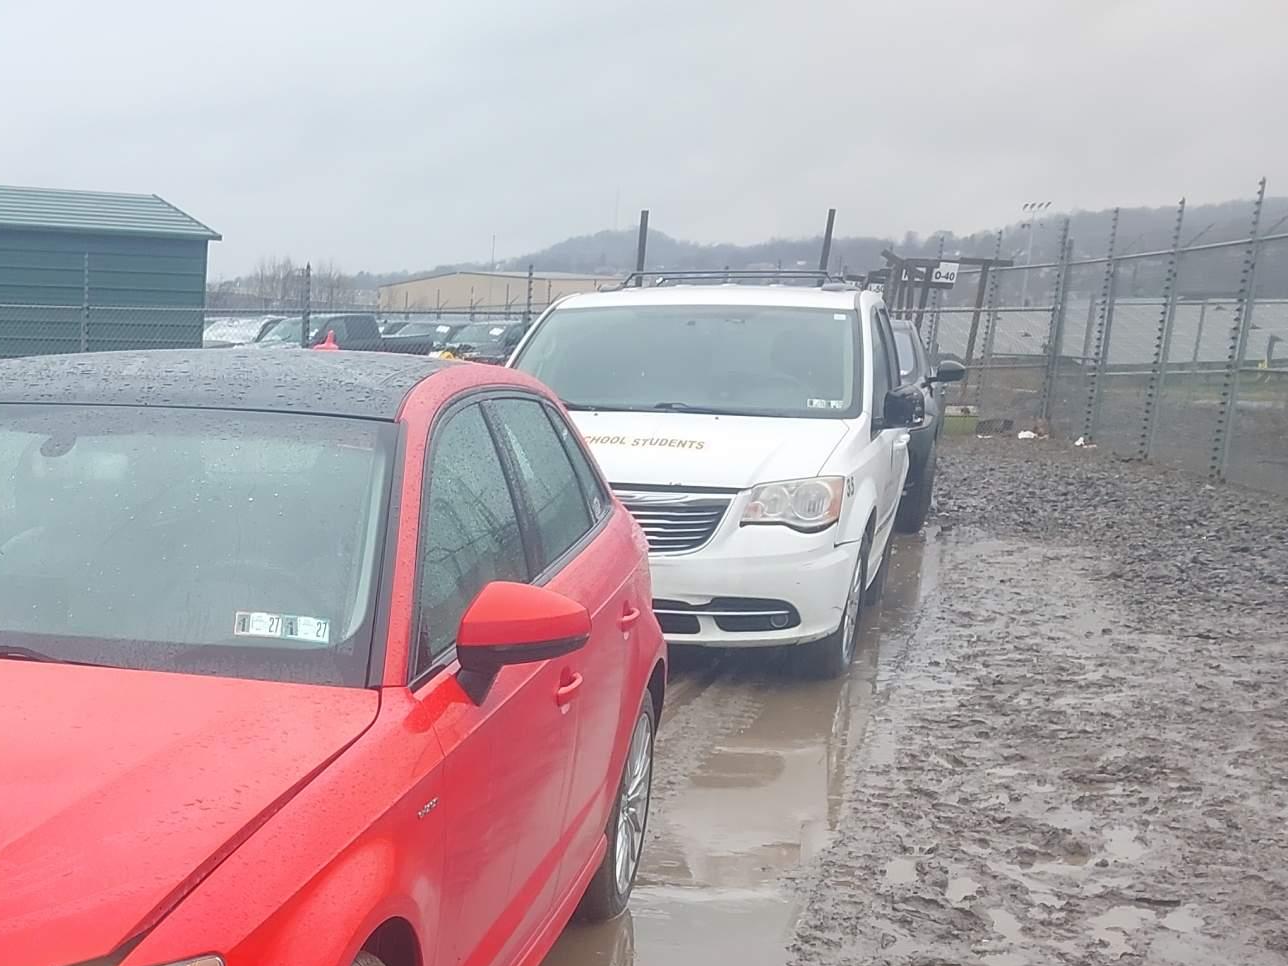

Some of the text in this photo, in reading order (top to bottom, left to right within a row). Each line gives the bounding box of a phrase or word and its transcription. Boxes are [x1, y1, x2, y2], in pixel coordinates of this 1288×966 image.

[584, 435, 705, 450] CHOOL STUDENTS
[268, 616, 280, 633] 27
[315, 621, 327, 639] 27
